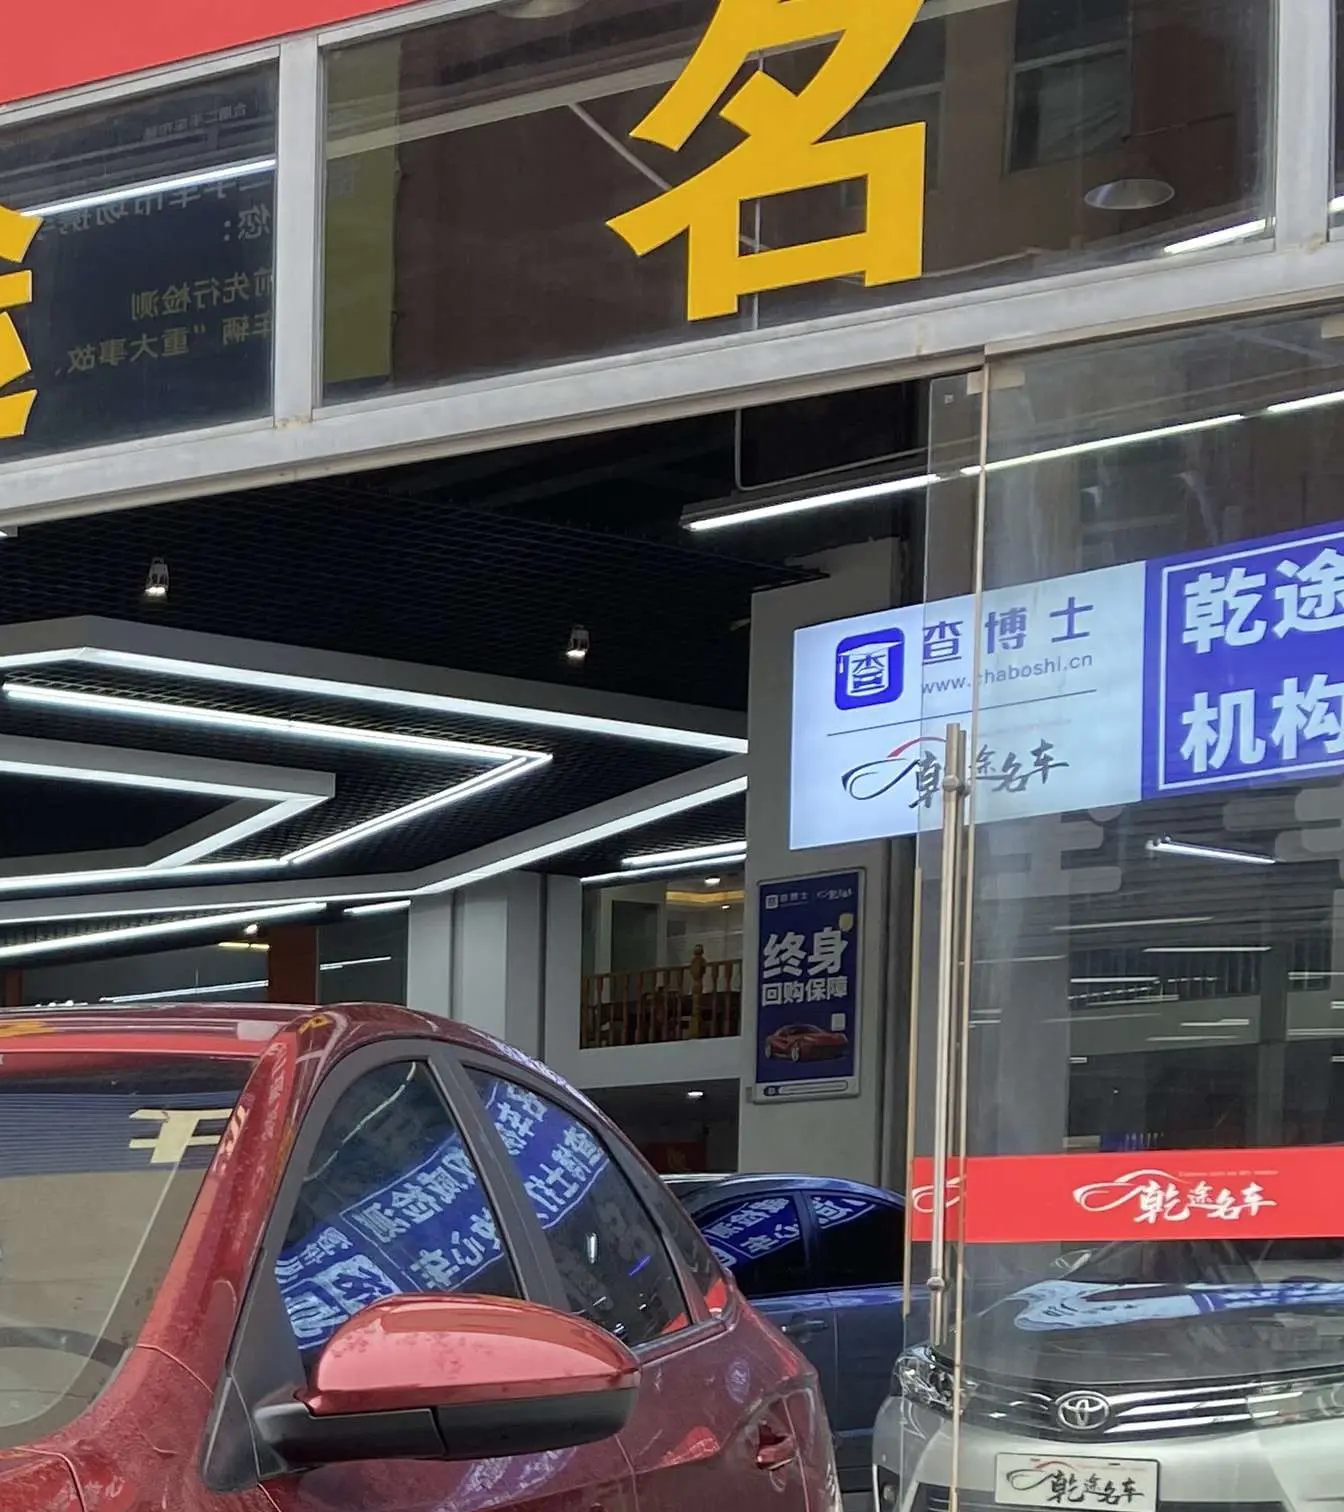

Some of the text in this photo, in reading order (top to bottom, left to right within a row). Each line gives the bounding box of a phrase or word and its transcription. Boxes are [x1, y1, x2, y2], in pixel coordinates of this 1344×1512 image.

[922, 596, 1094, 666] 查博士
[922, 653, 1094, 695] www.haboshi.cn
[762, 927, 849, 979] 终身
[762, 975, 849, 1007] 回购保障
[1134, 1180, 1278, 1224] 乾途名车
